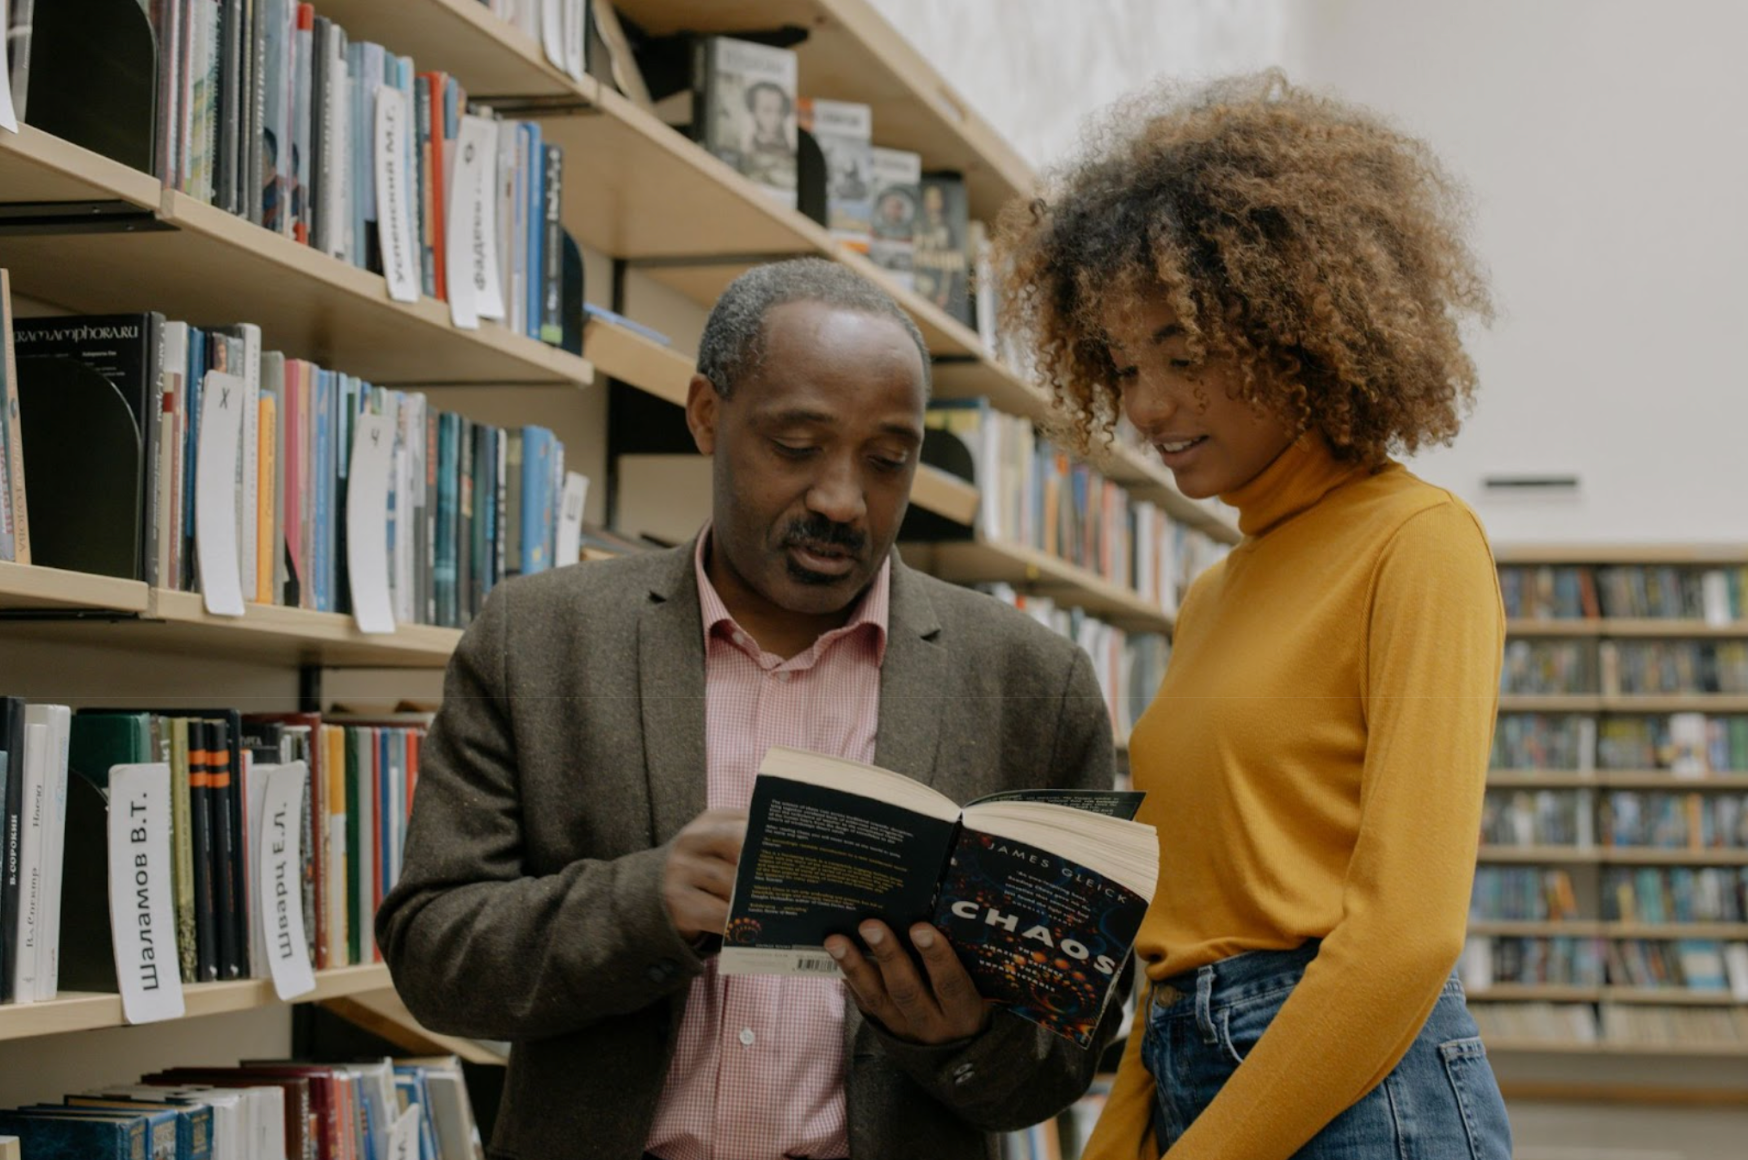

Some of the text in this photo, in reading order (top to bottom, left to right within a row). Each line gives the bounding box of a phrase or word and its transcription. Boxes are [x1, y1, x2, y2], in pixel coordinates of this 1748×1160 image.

[386, 161, 405, 283] Успенский
[9, 814, 18, 873] СОРОКИН
[131, 792, 160, 991] Шаламов В.Т.
[273, 801, 294, 960] Шварц Е.Л.
[988, 842, 1127, 904] JAMES GLEICK
[951, 900, 1116, 976] CHAOS
